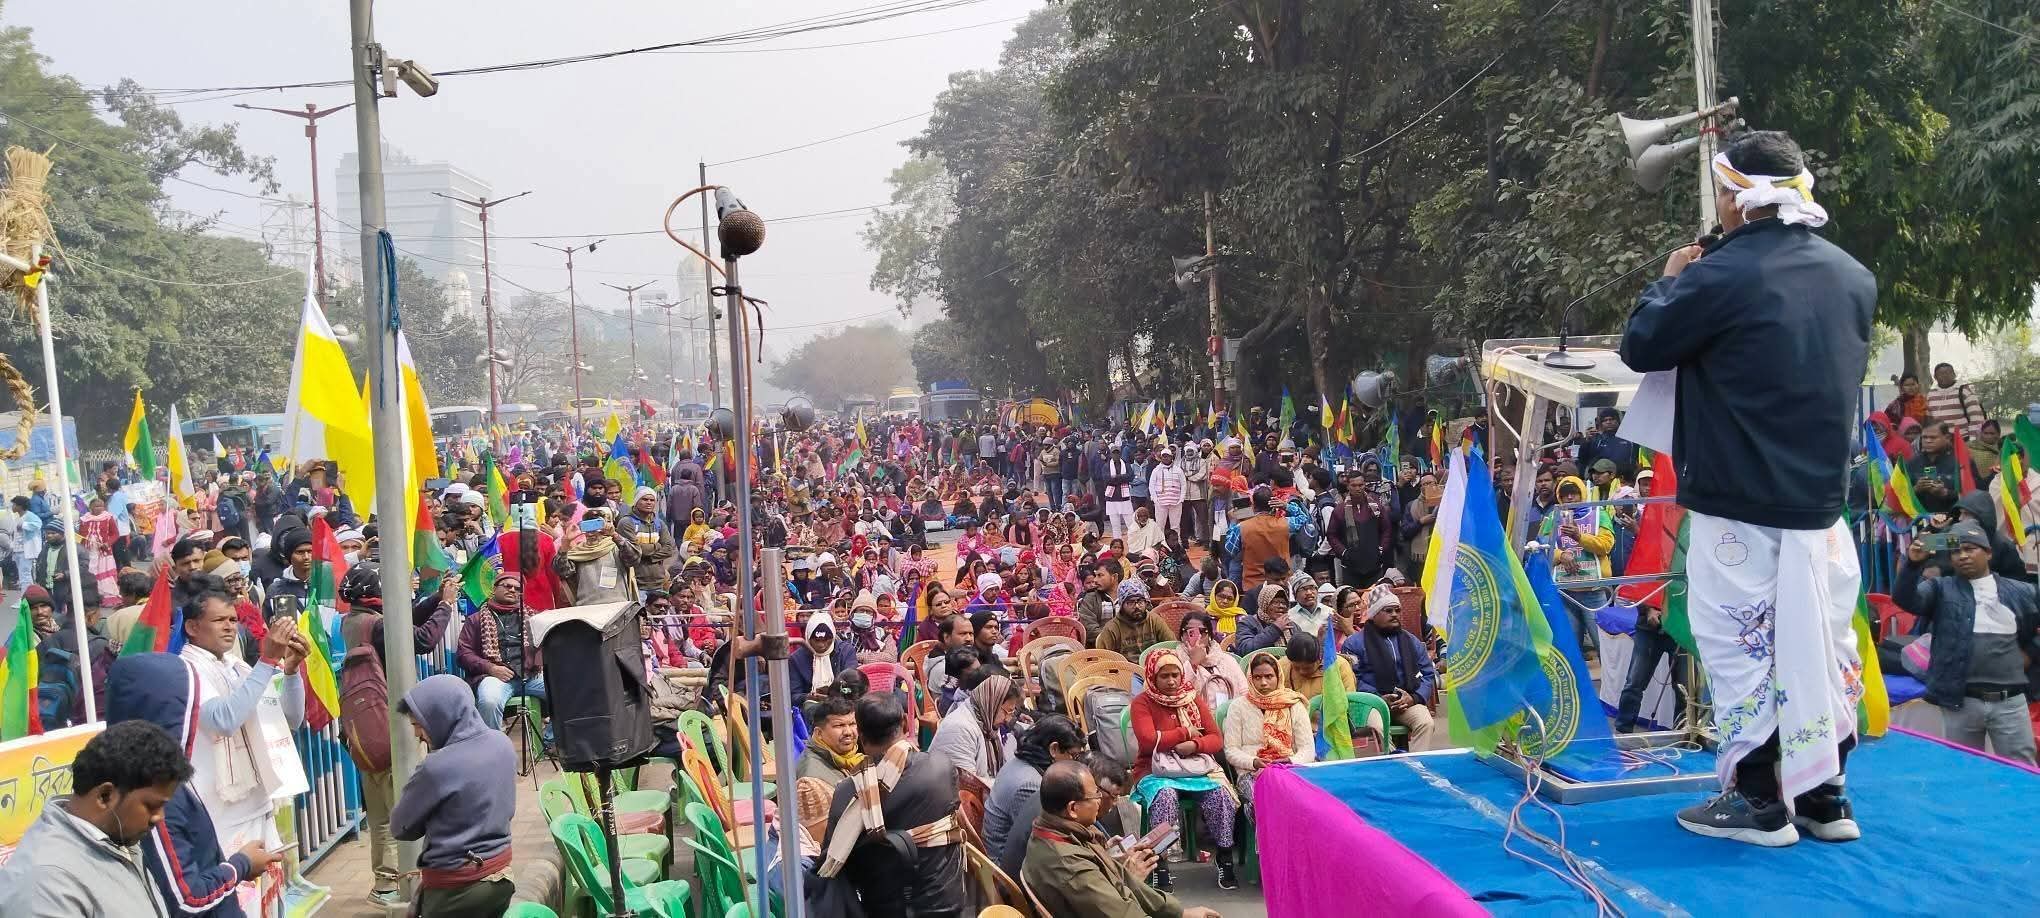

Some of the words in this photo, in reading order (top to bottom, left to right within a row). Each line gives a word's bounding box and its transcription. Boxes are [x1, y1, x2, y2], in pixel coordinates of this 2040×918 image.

[1481, 584, 1491, 608] TRIBE
[1477, 612, 1491, 653] WELFARE
[1556, 702, 1573, 741] WELFARE
